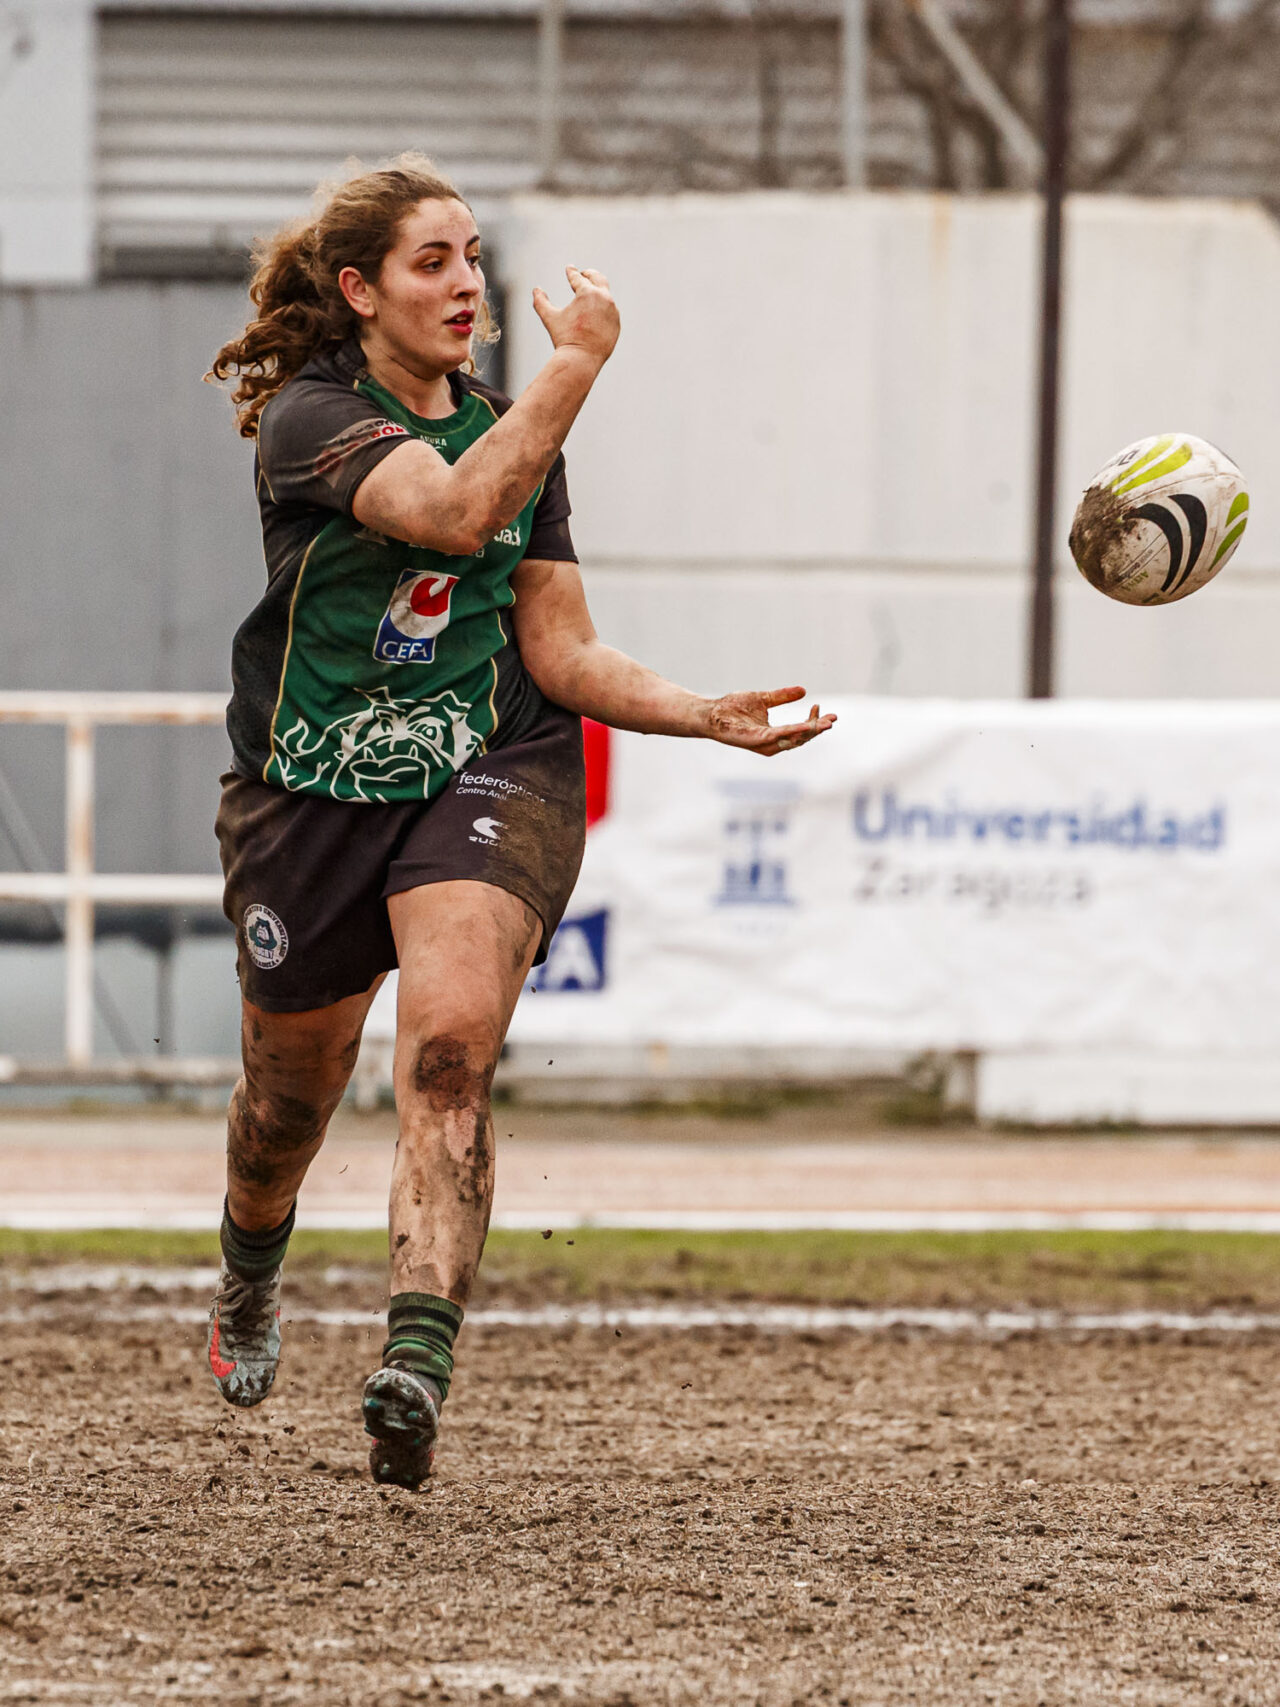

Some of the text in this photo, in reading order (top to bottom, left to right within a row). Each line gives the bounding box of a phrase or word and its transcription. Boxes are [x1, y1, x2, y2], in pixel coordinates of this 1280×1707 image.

[381, 641, 428, 660] CEFA
[455, 786, 487, 796] Centro
[854, 788, 1226, 853] Universidad
